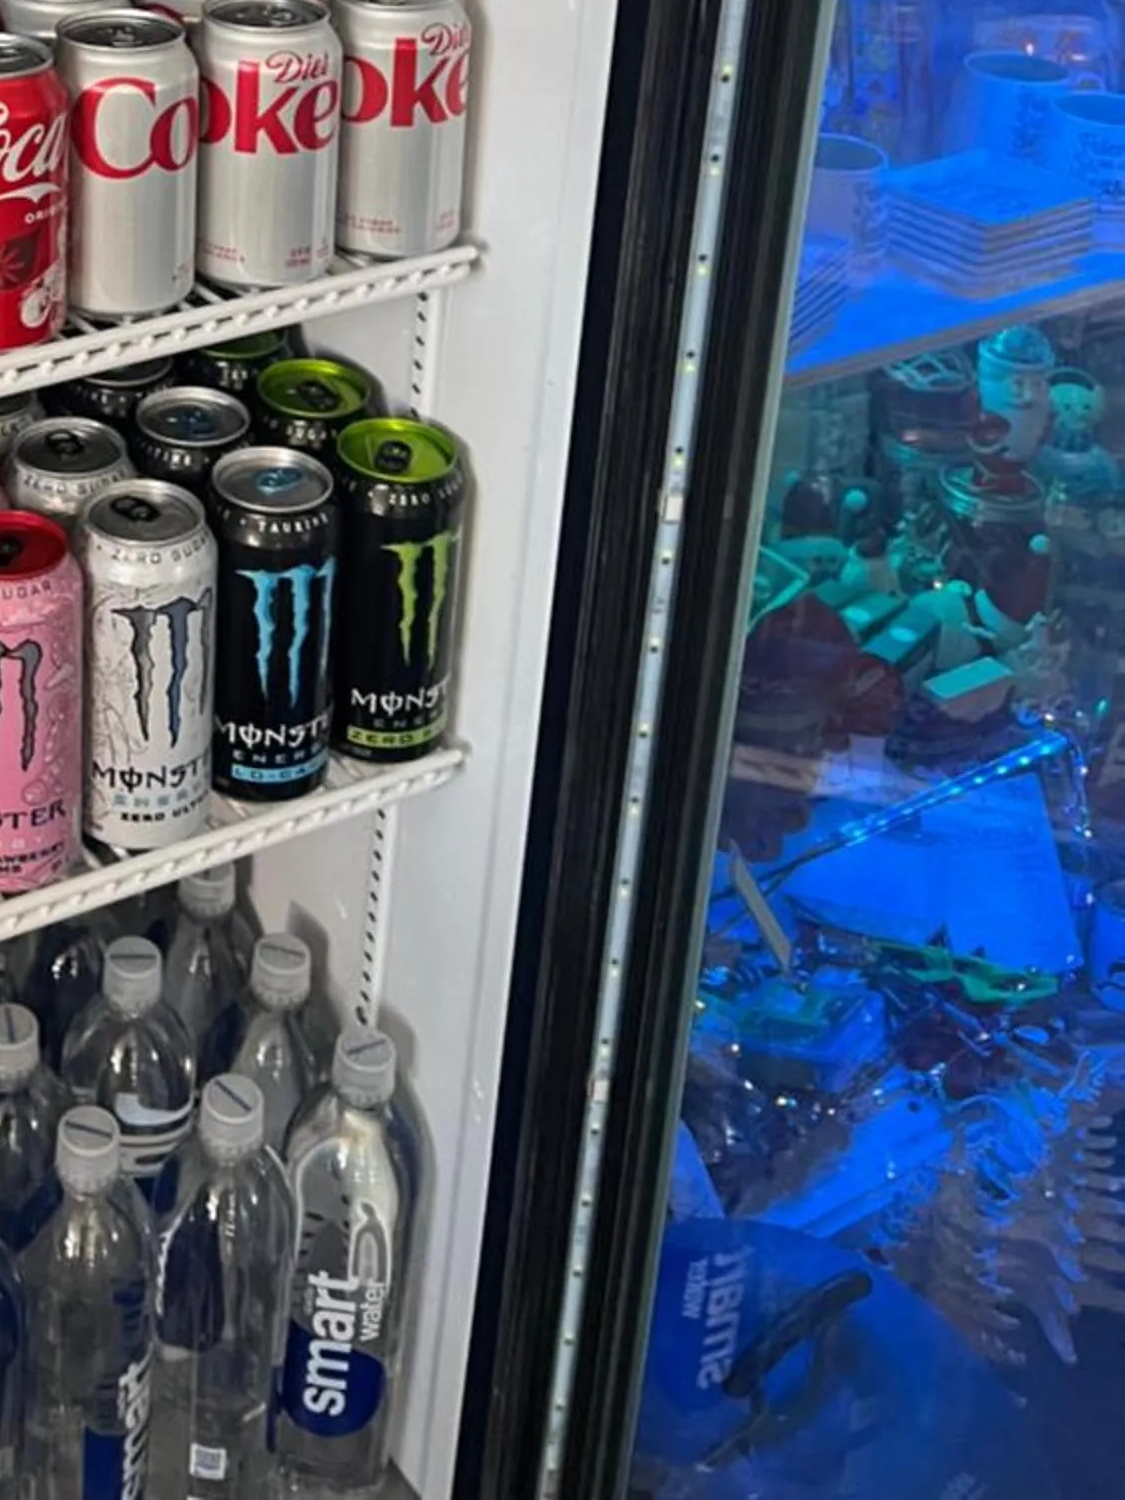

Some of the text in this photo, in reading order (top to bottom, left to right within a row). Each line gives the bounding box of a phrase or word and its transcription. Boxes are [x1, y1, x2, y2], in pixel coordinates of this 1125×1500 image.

[264, 49, 330, 84] Diet
[352, 729, 415, 745] ZERO
[359, 1280, 388, 1342] water
[302, 1269, 360, 1418] smart
